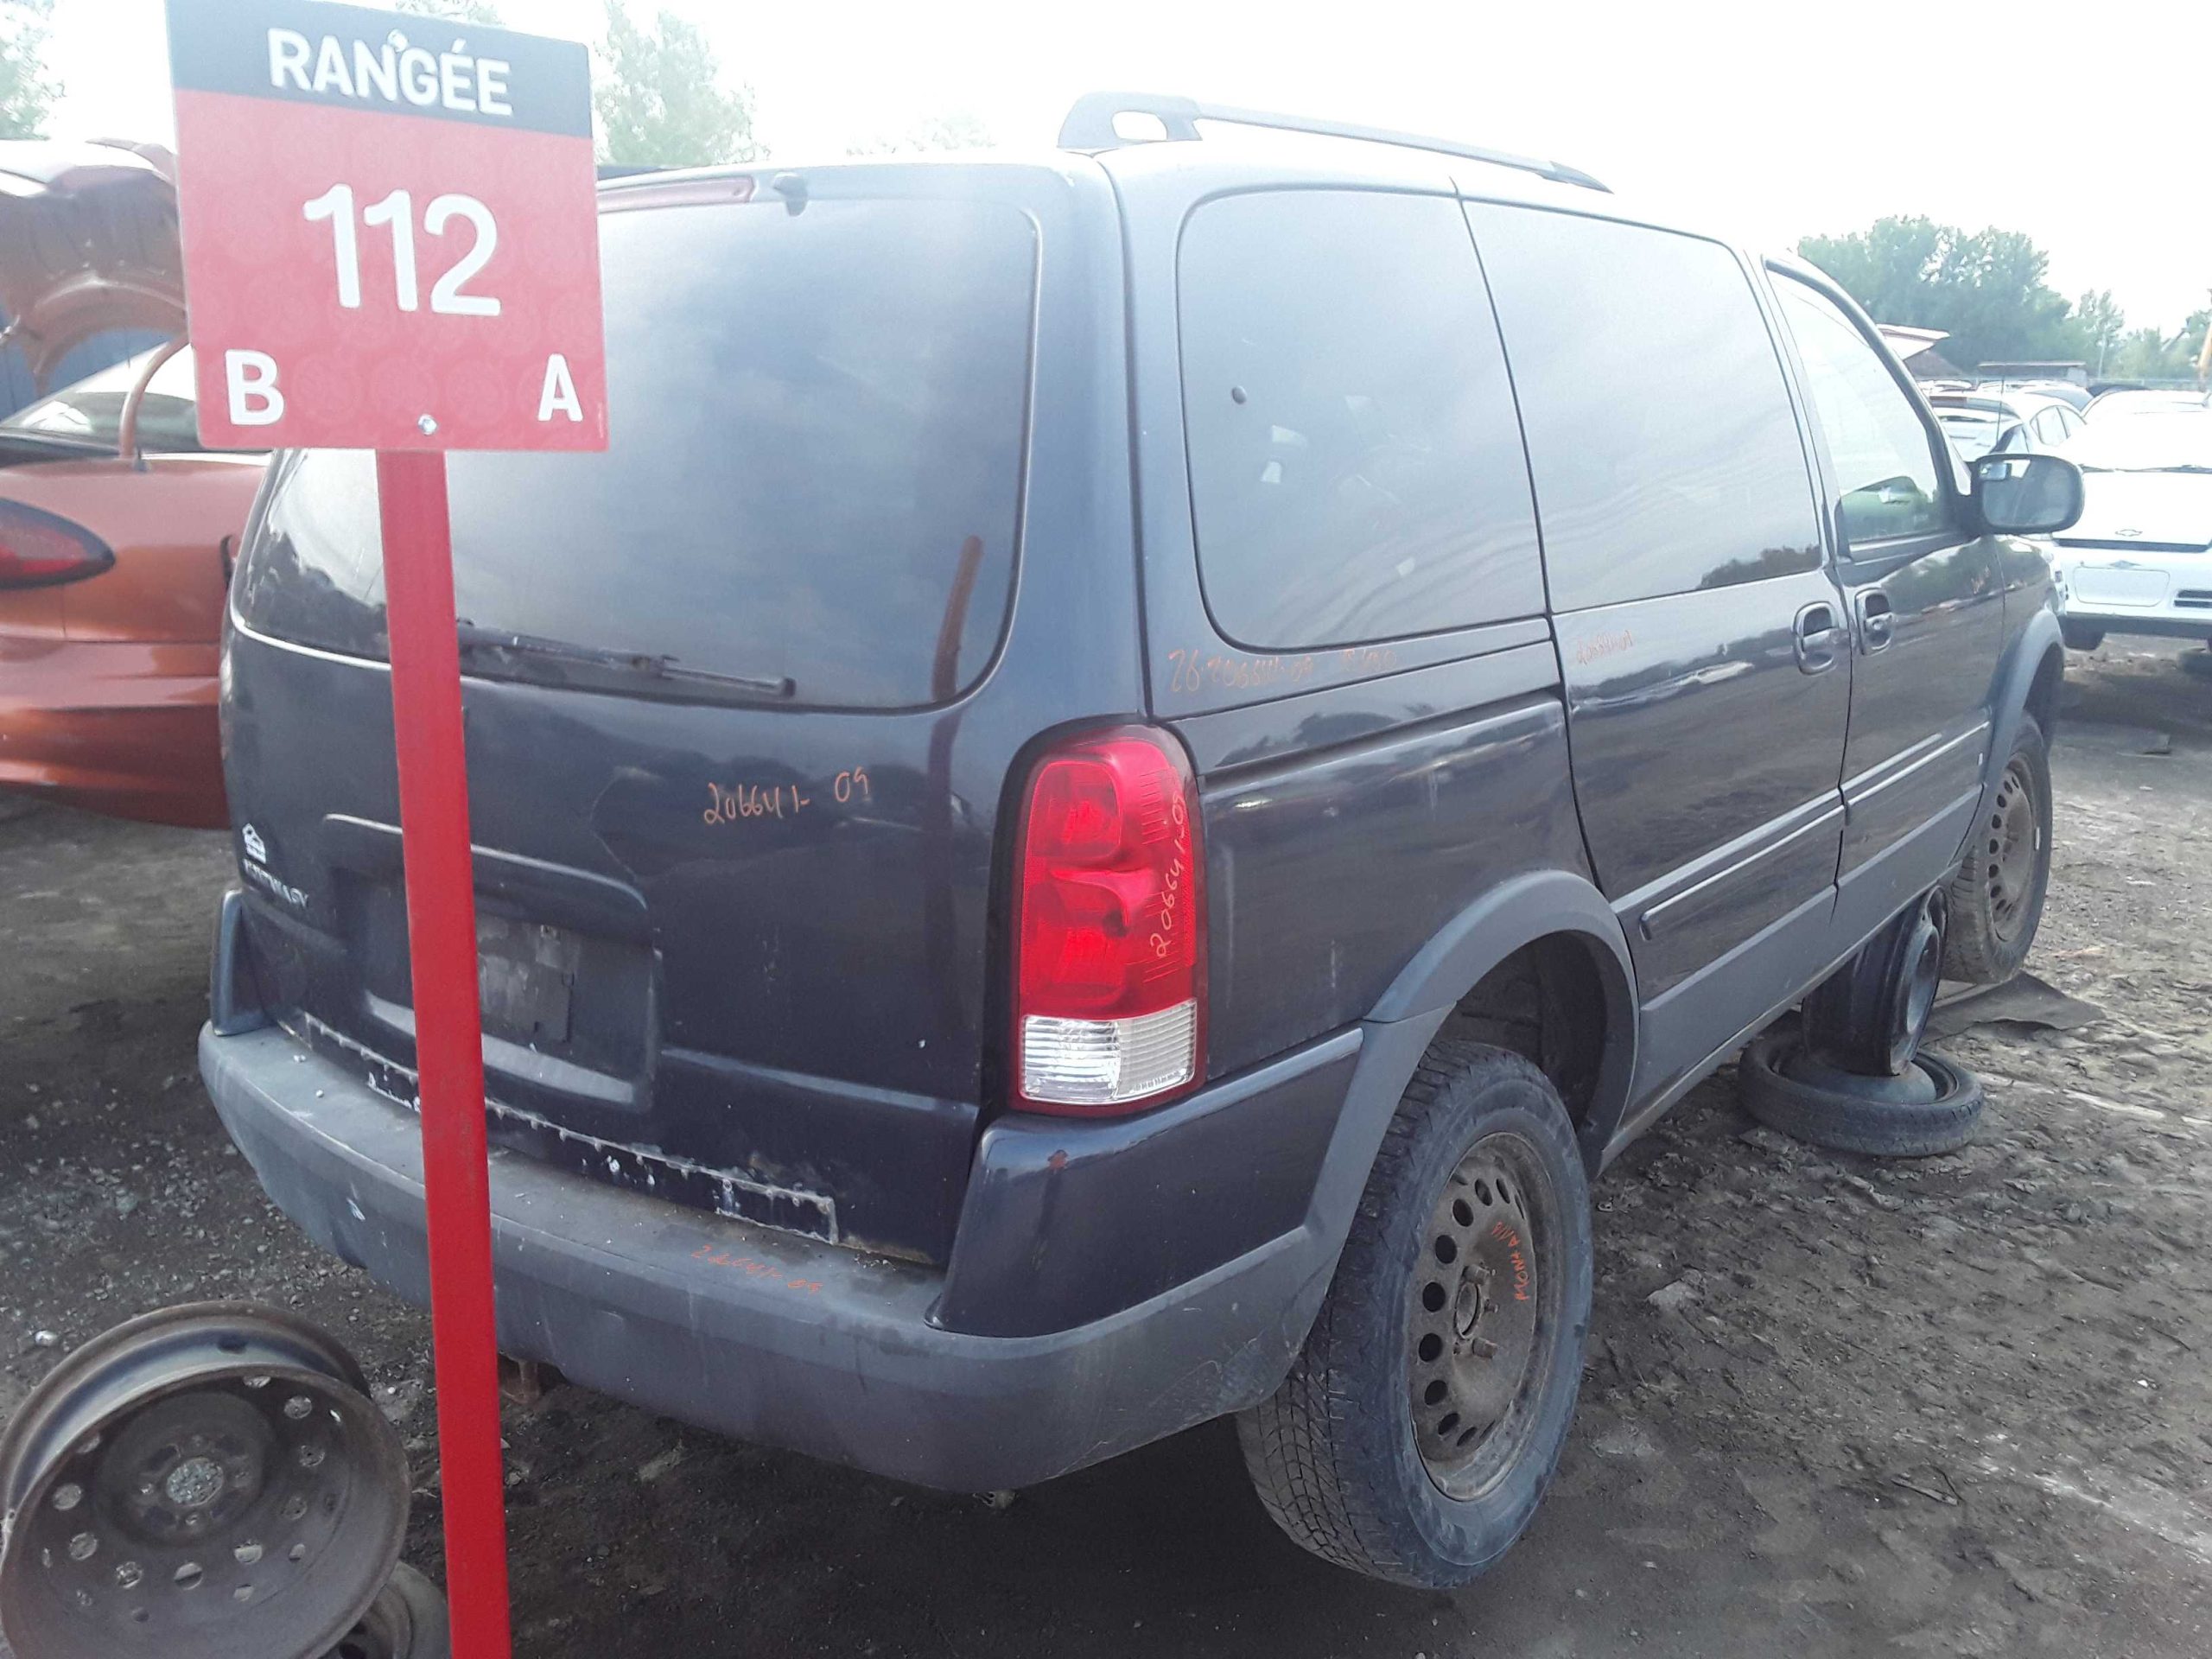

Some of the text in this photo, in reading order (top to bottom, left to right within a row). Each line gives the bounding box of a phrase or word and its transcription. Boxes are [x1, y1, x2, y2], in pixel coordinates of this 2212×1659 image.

[267, 28, 513, 116] RANGÉE
[303, 183, 502, 316] 112
[225, 349, 583, 426] B A
